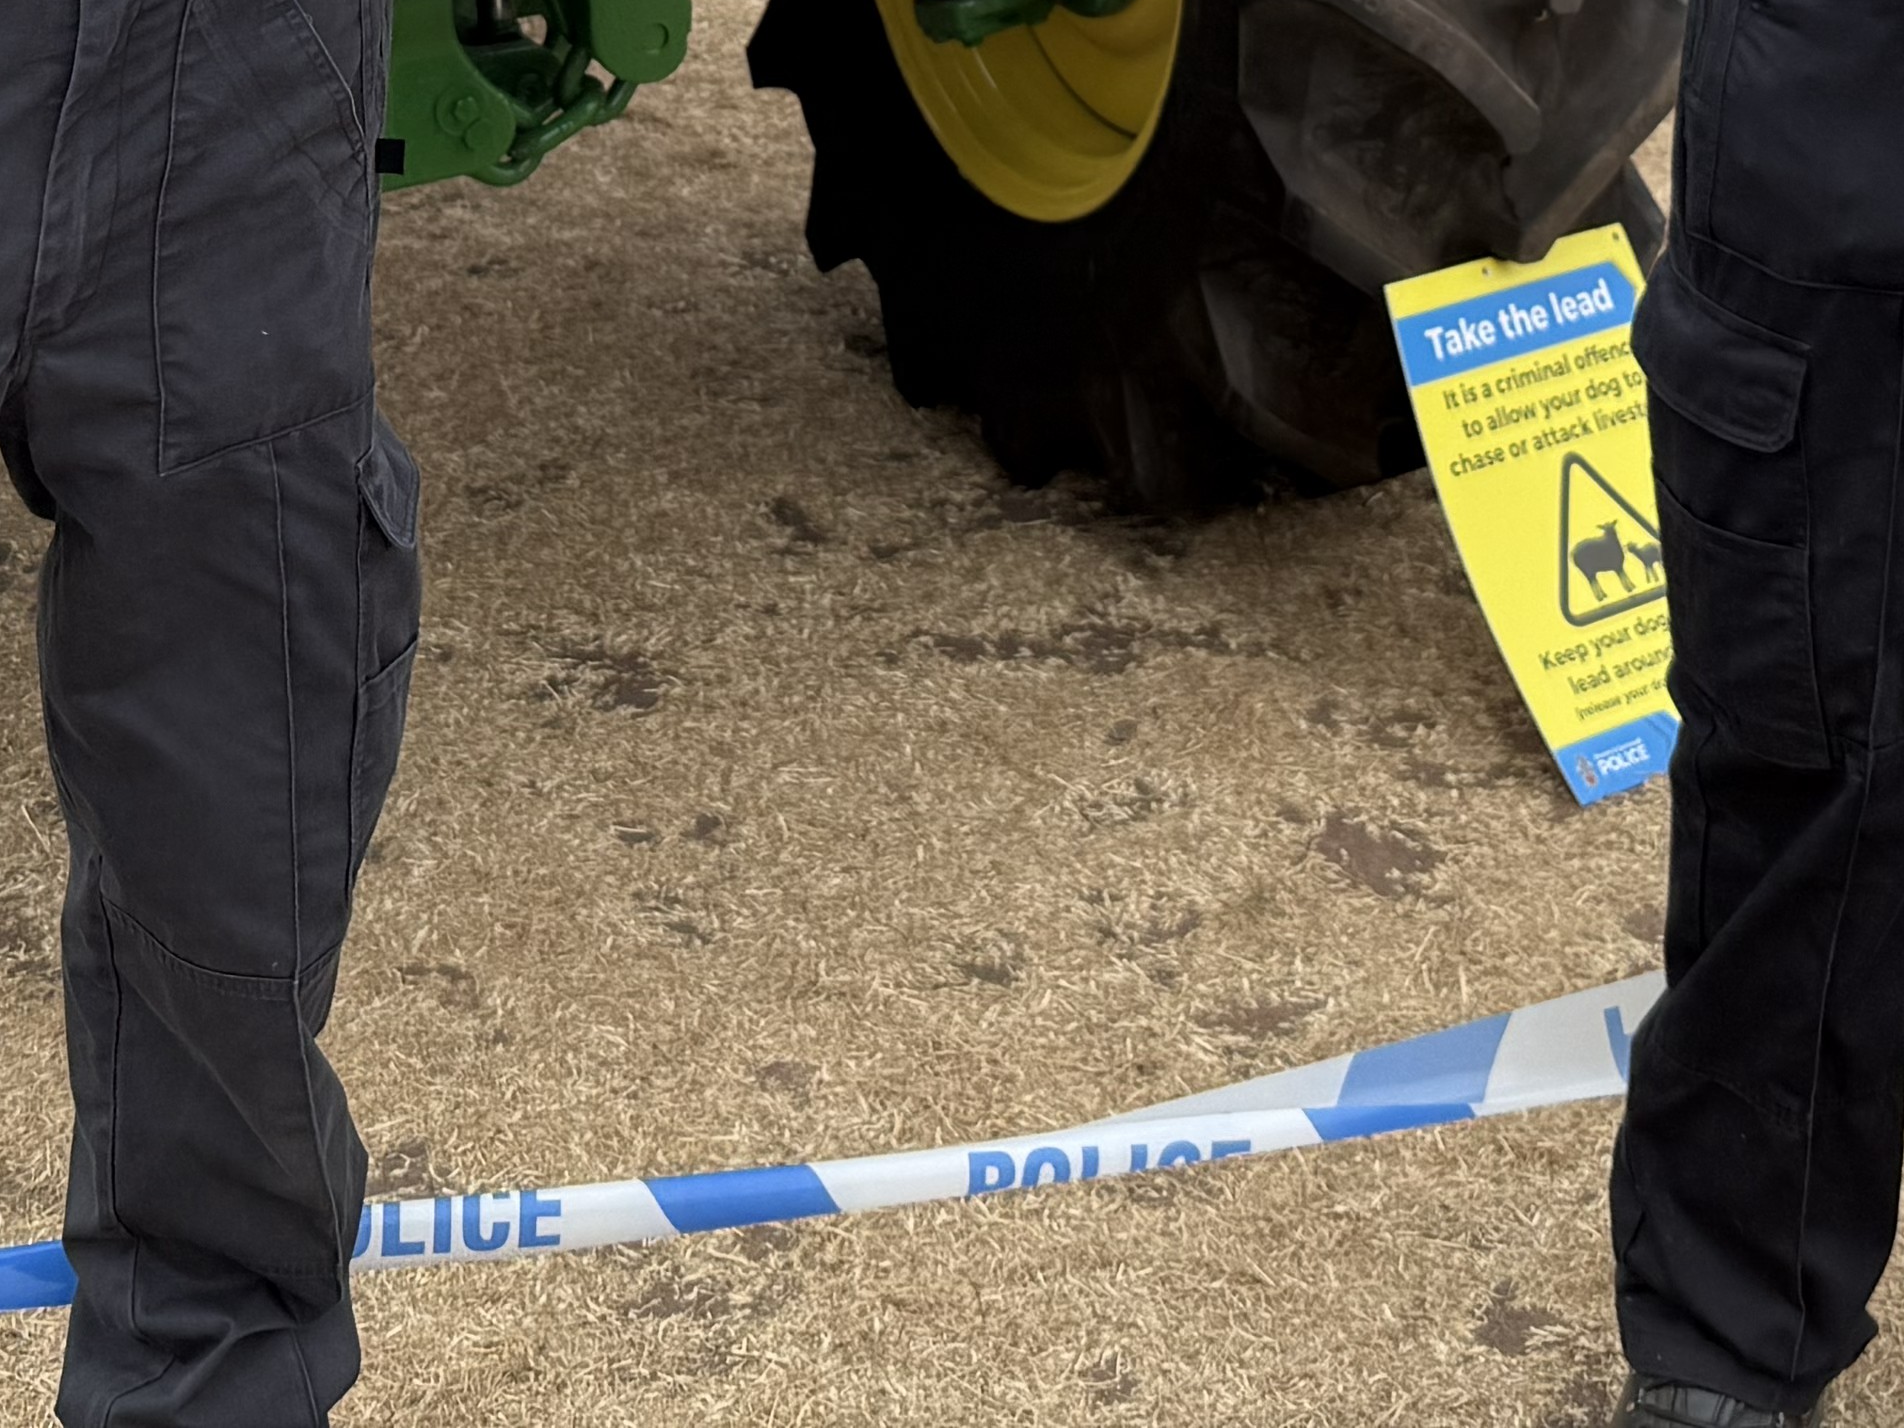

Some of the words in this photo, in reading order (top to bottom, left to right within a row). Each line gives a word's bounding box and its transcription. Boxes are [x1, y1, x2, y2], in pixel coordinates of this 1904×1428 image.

[1424, 317, 1496, 360] Take
[1499, 304, 1548, 339] the
[1548, 278, 1615, 325] lead
[1443, 390, 1460, 410] It
[1462, 384, 1478, 404] is
[1482, 384, 1493, 398] a
[1495, 353, 1571, 394] criminal
[1462, 419, 1484, 438] to
[1488, 402, 1537, 431] allow
[1539, 389, 1582, 419] your
[1585, 376, 1622, 402] dog
[1622, 371, 1643, 389] to
[1449, 447, 1505, 477] chase
[1509, 440, 1529, 458] or
[1533, 417, 1593, 452] attack
[1538, 643, 1589, 671] Keep
[1589, 625, 1633, 657] your
[1568, 664, 1612, 695] lead
[1597, 744, 1650, 775] POLICE
